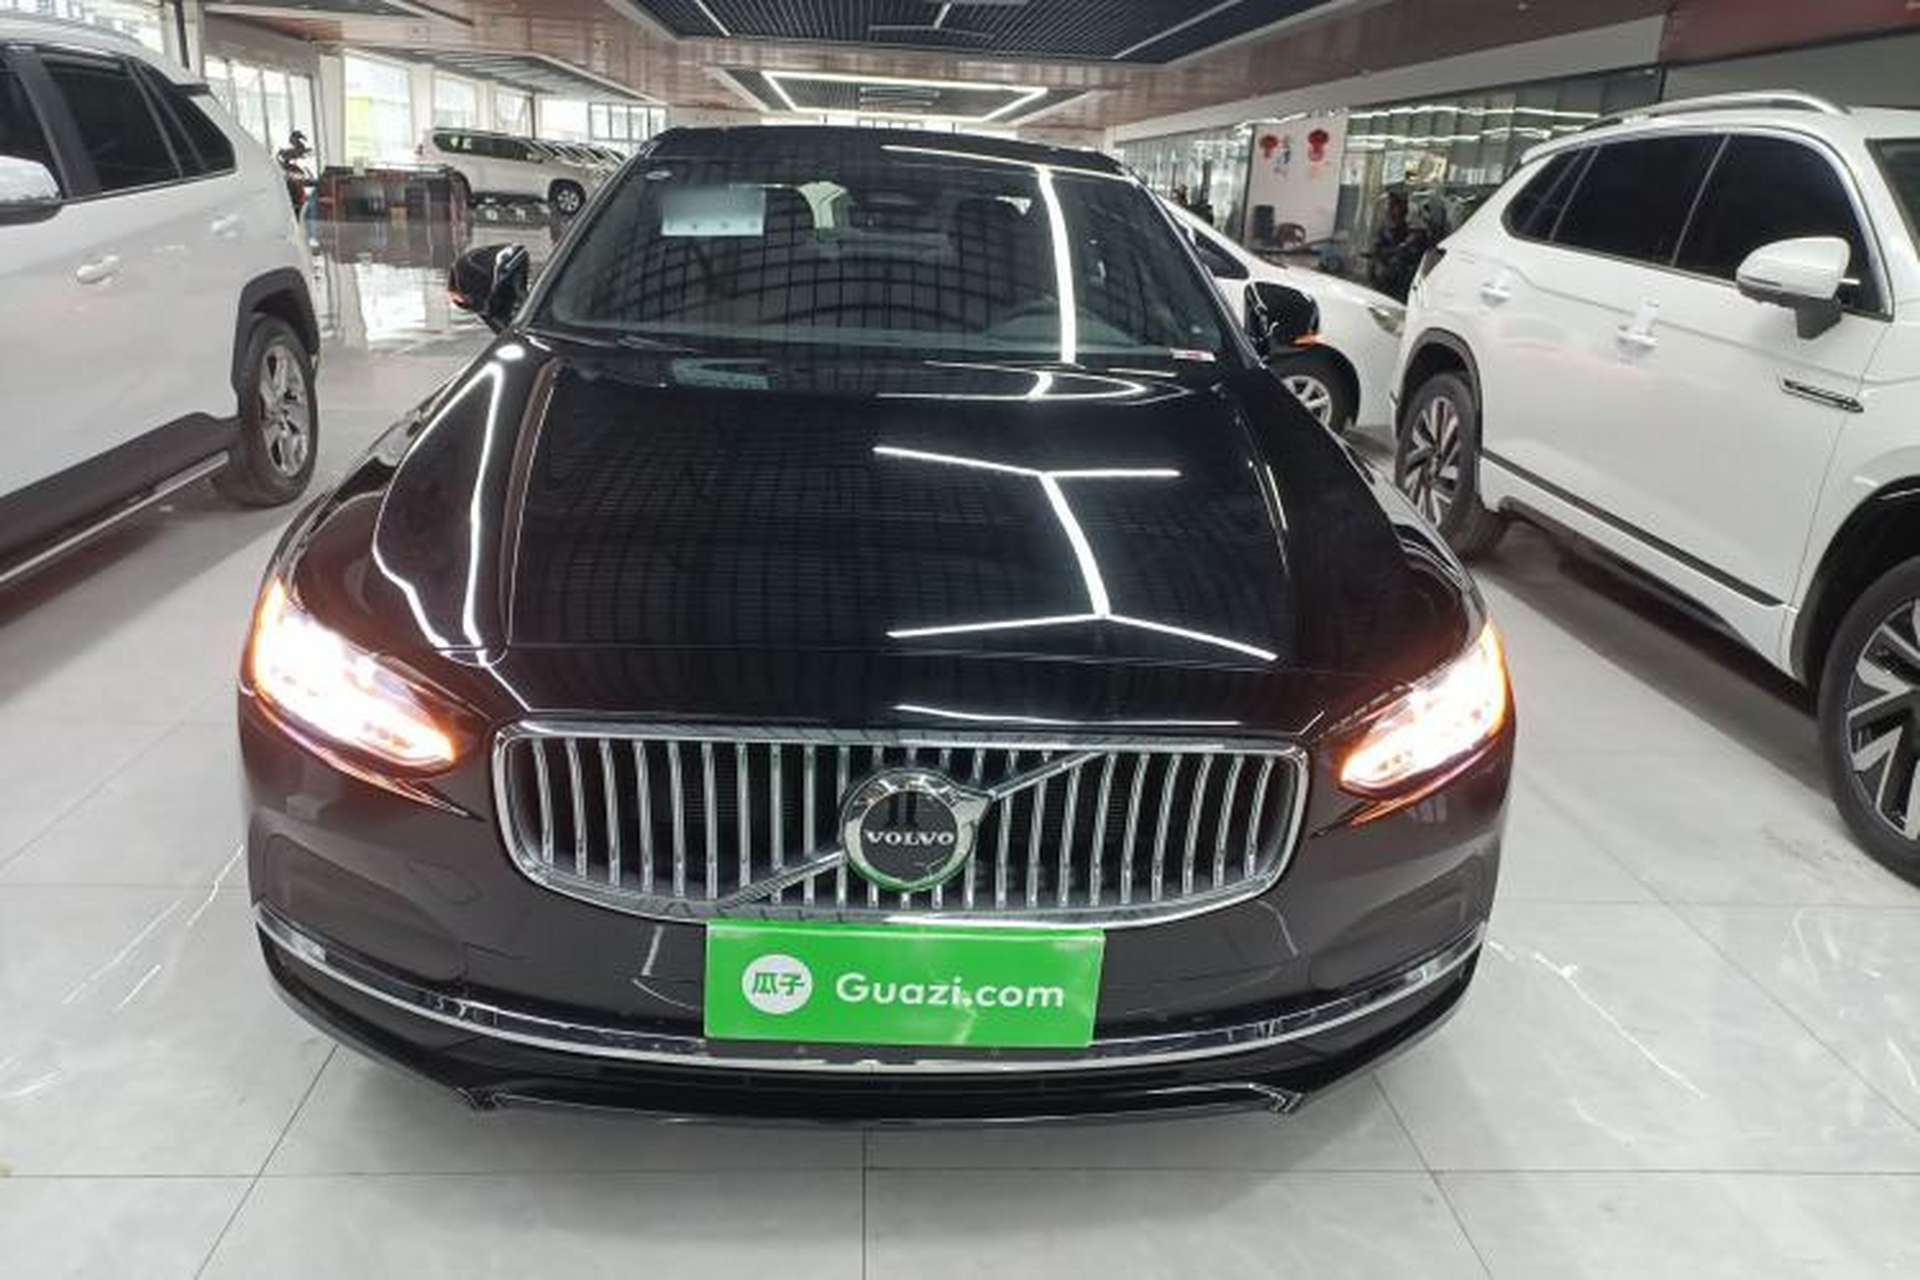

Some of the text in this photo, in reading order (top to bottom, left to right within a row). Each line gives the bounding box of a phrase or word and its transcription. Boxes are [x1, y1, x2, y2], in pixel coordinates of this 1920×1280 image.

[863, 830, 954, 846] VOLVO
[751, 972, 805, 997] 瓜子
[835, 972, 1065, 1008] Guazi.com
